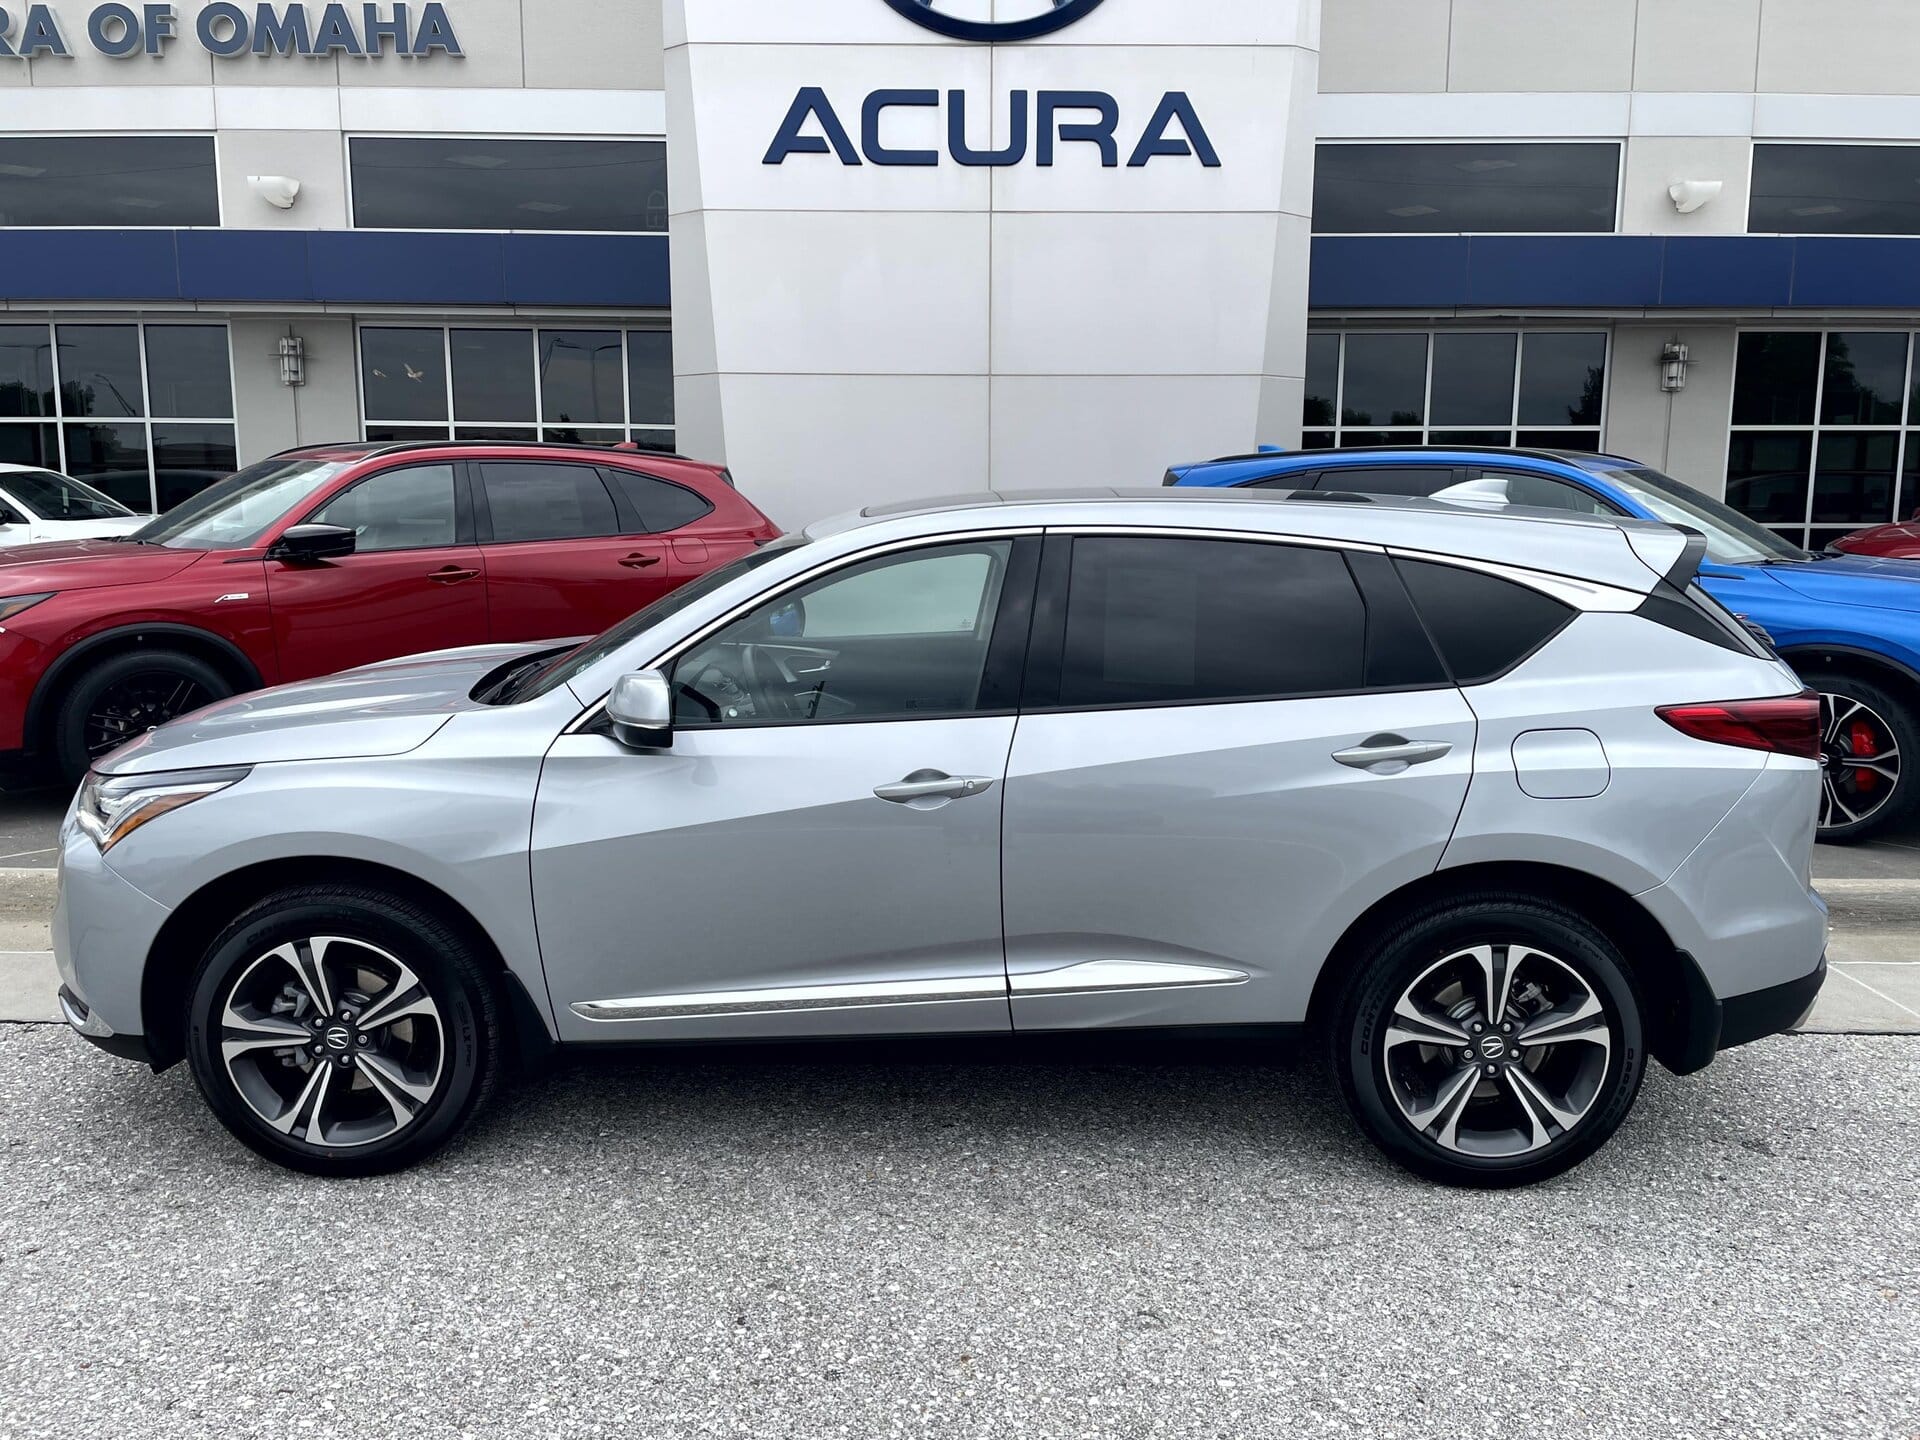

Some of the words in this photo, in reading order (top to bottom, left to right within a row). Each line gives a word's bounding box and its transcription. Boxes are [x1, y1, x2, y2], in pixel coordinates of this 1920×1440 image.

[87, 2, 177, 57] OF
[196, 2, 464, 57] OMAHA
[761, 86, 1222, 167] ACURA
